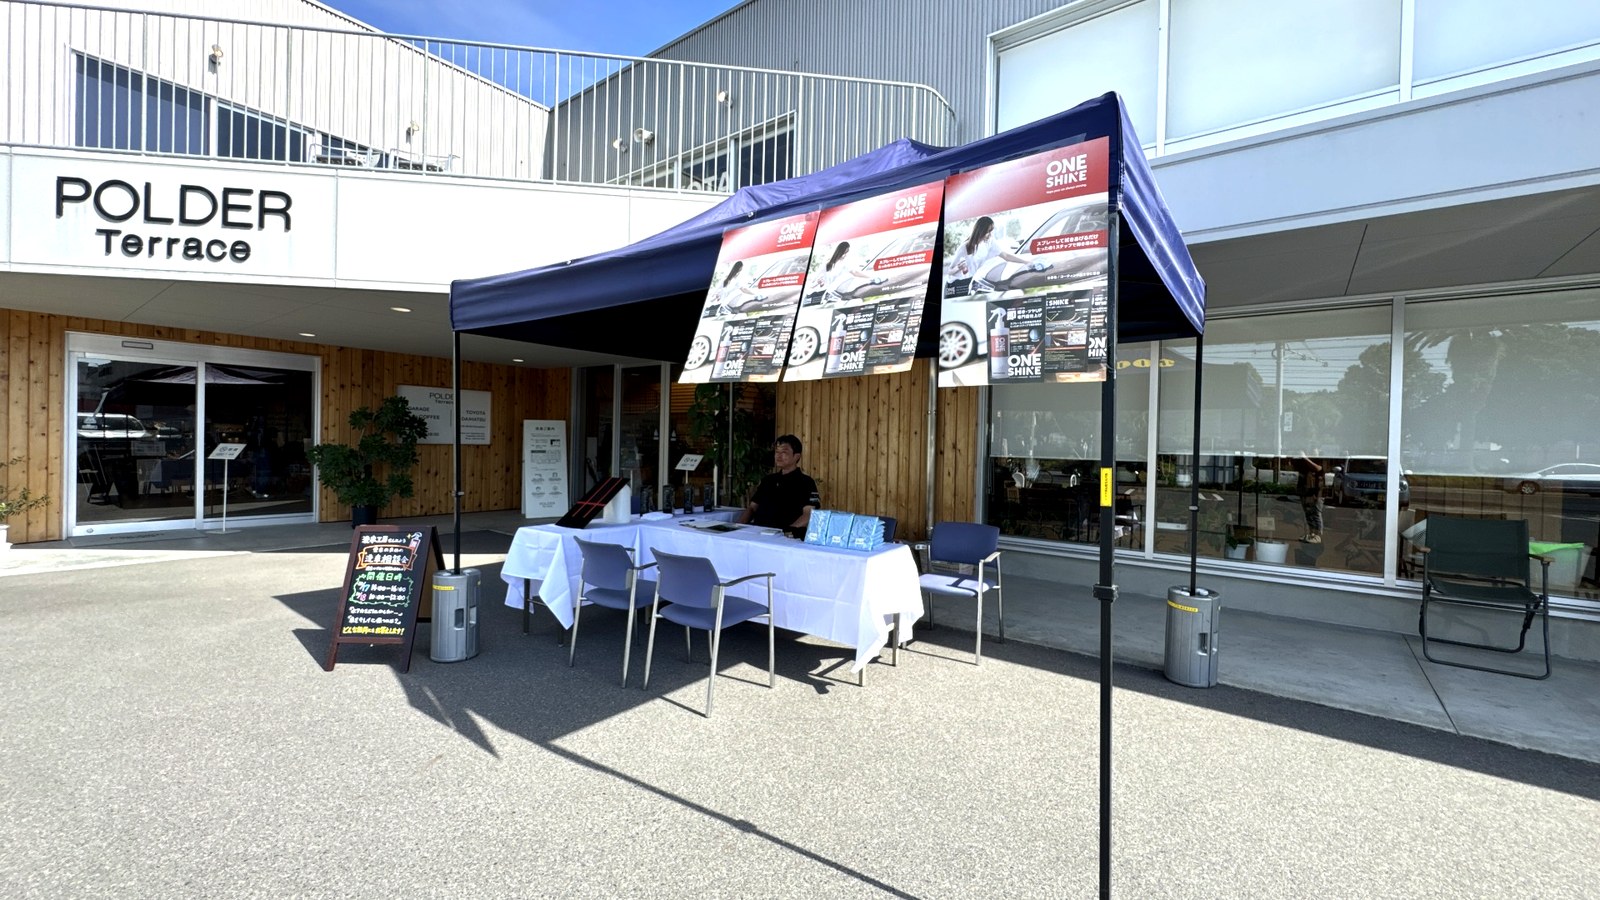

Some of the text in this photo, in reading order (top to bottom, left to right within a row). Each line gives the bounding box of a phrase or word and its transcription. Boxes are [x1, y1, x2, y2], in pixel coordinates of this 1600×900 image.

[1046, 153, 1088, 176] ONE
[1046, 170, 1087, 188] SHINE
[56, 175, 293, 232] POLDER
[895, 193, 927, 210] ONE
[893, 205, 925, 219] SHINE
[780, 221, 806, 235] ONE
[95, 229, 251, 262] Terrace
[841, 350, 867, 363] ONE
[1007, 353, 1042, 367] ONE
[723, 360, 745, 370] ONE
[1007, 366, 1042, 376] SHINE
[429, 392, 454, 400] POLDE
